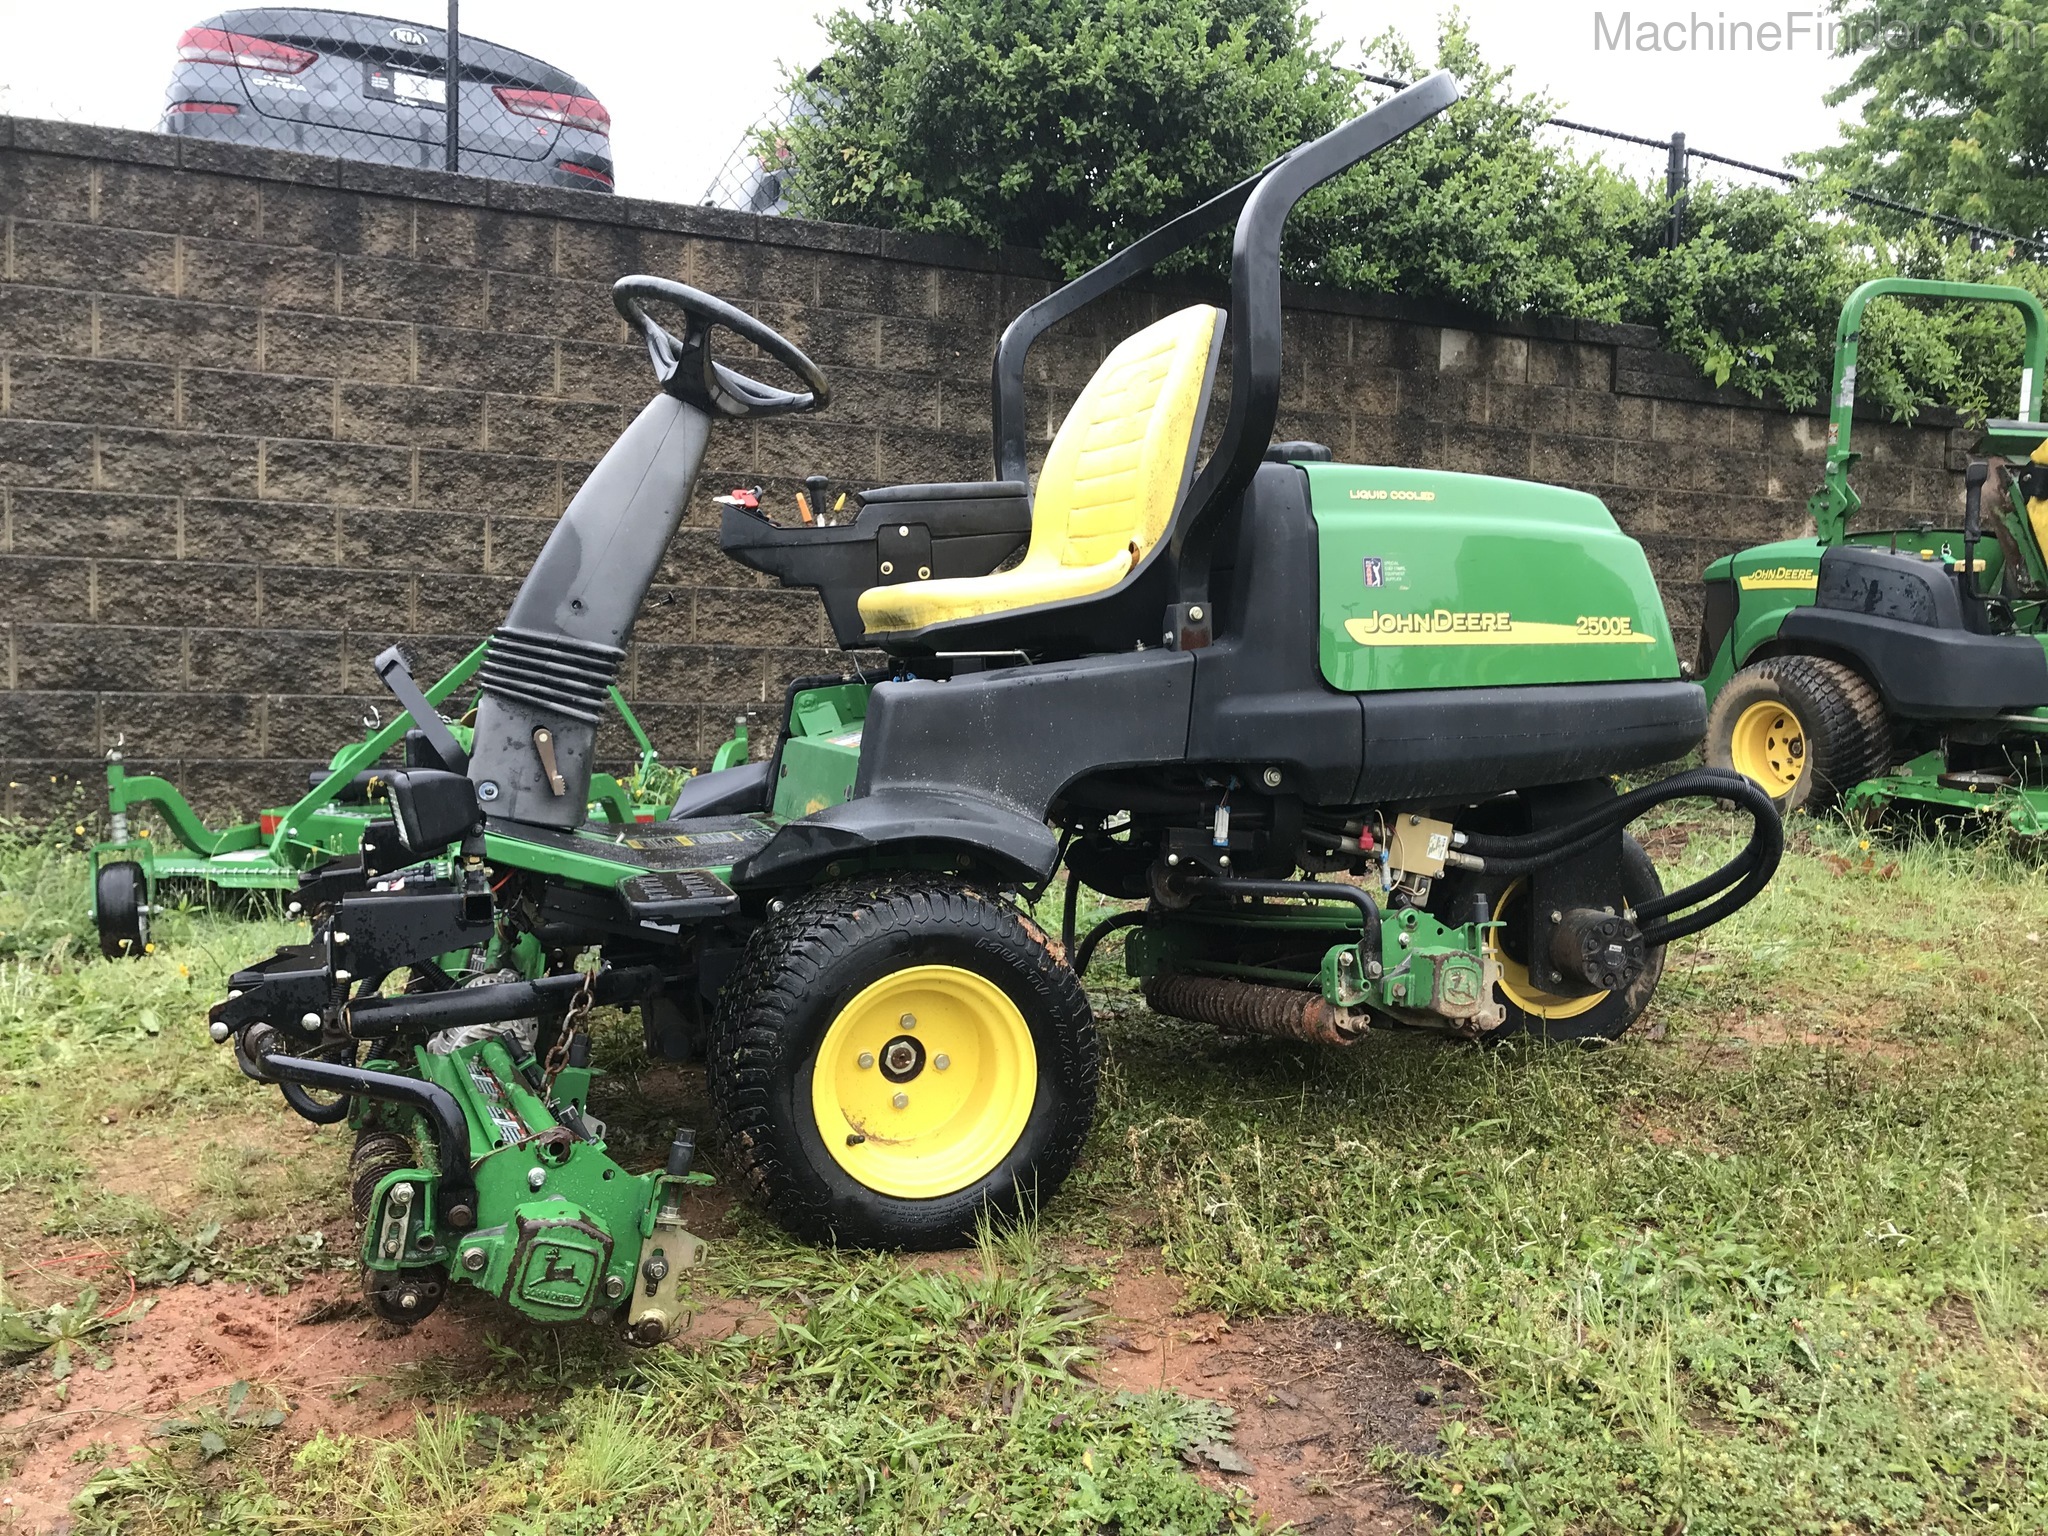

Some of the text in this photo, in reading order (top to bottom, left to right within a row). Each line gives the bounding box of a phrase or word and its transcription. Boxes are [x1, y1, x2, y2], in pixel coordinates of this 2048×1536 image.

[394, 30, 424, 45] KIA
[1349, 489, 1435, 501] LIQUID COOLED
[1748, 566, 1814, 581] JOHN DEERE
[1364, 609, 1633, 635] JOHN DEERE 2500E
[974, 936, 1050, 996] MULTI
